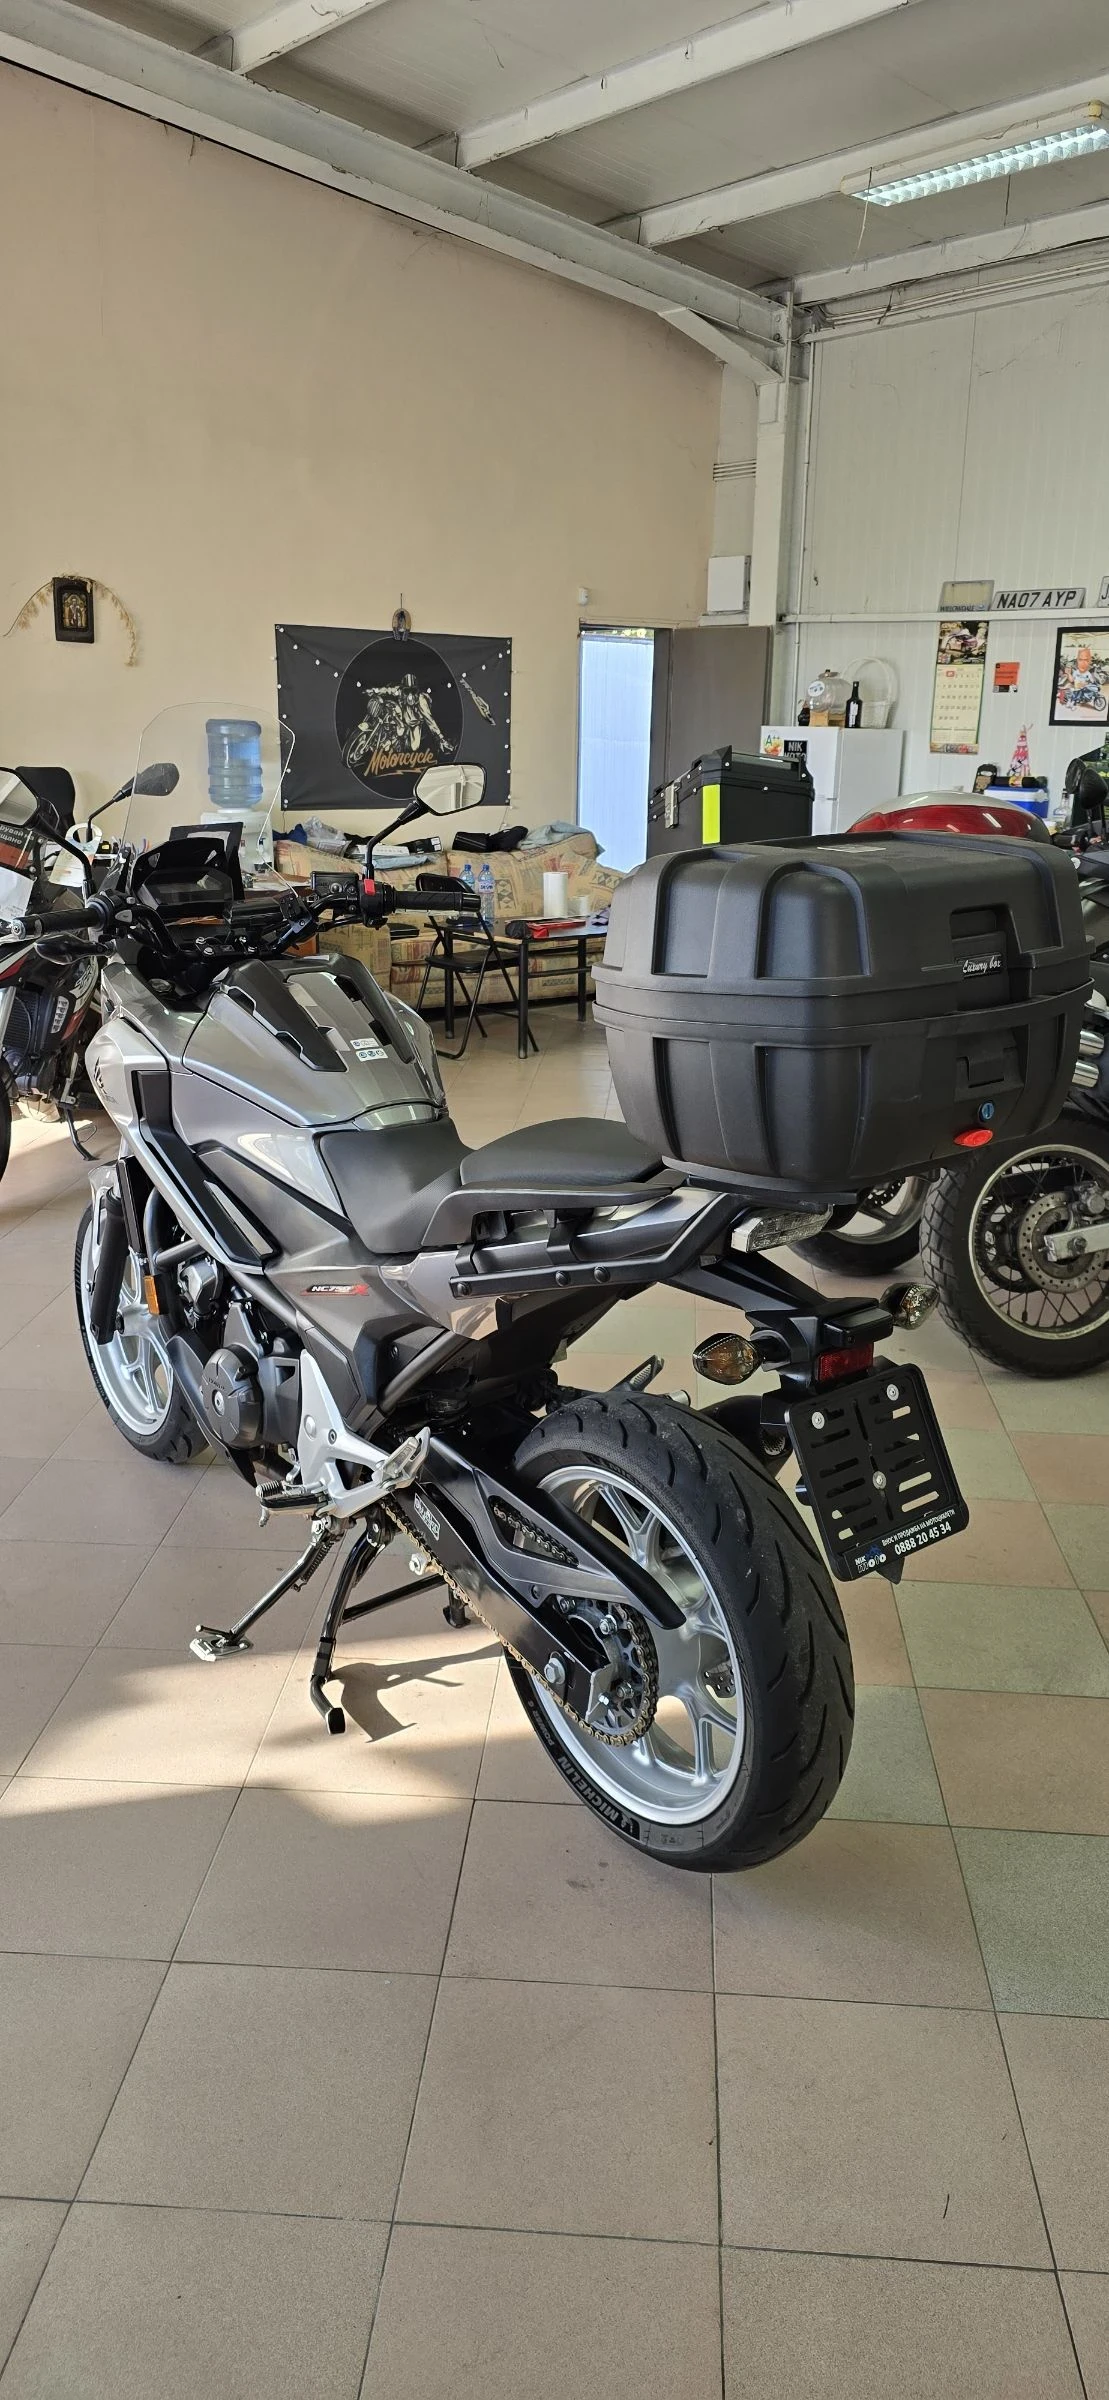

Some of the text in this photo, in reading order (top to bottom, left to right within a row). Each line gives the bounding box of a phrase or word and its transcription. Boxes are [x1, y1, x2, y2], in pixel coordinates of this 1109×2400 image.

[996, 590, 1076, 609] NA07 AYP
[788, 742, 803, 752] NIK
[364, 748, 437, 776] Motorcycle
[963, 960, 988, 973] Luxury
[895, 1521, 952, 1555] 0888 20 45 34
[557, 1755, 619, 1822] MICHELIN
